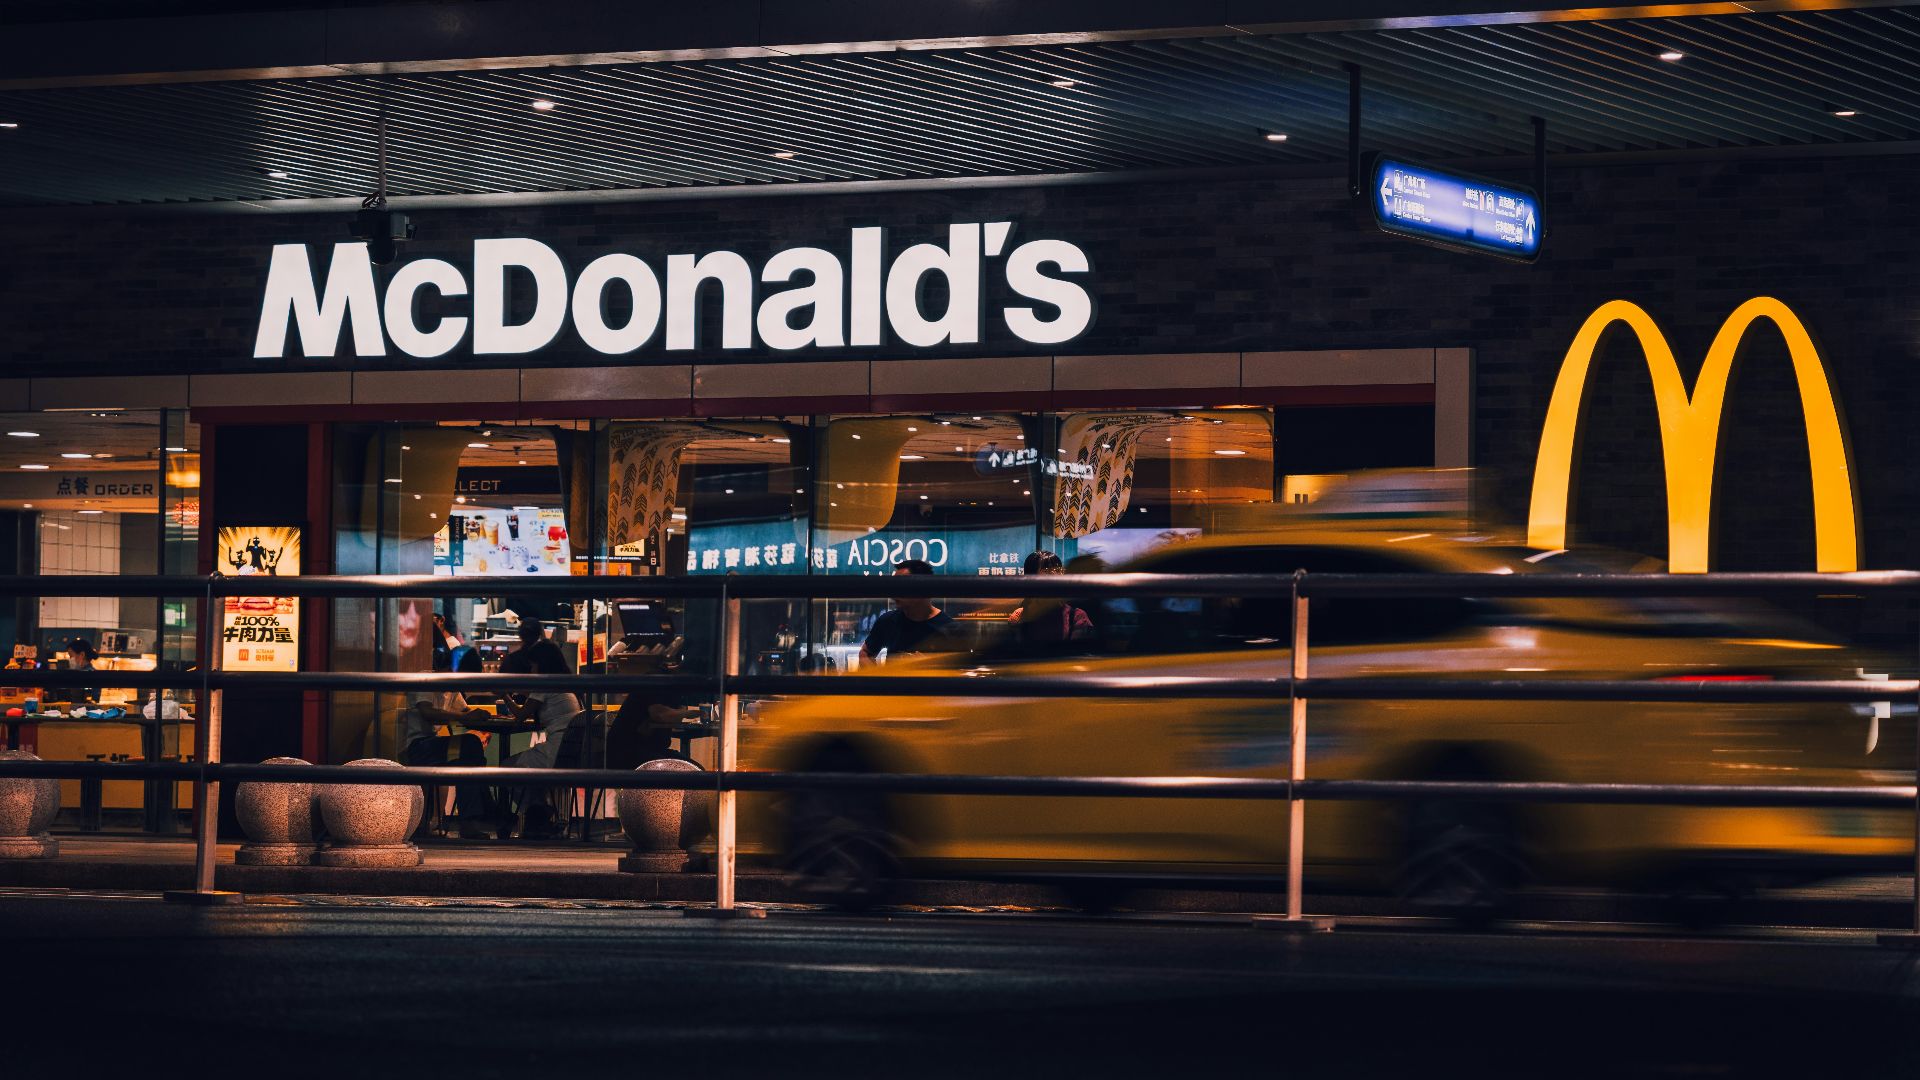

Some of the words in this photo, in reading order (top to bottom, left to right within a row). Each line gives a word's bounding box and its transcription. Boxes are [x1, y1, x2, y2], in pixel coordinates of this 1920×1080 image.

[254, 222, 1091, 358] McDonald's
[57, 476, 89, 495] 点餐
[95, 483, 154, 495] ORDER
[453, 480, 502, 492] LECT
[241, 616, 280, 626] 100%
[223, 626, 294, 643] 牛肉力量
